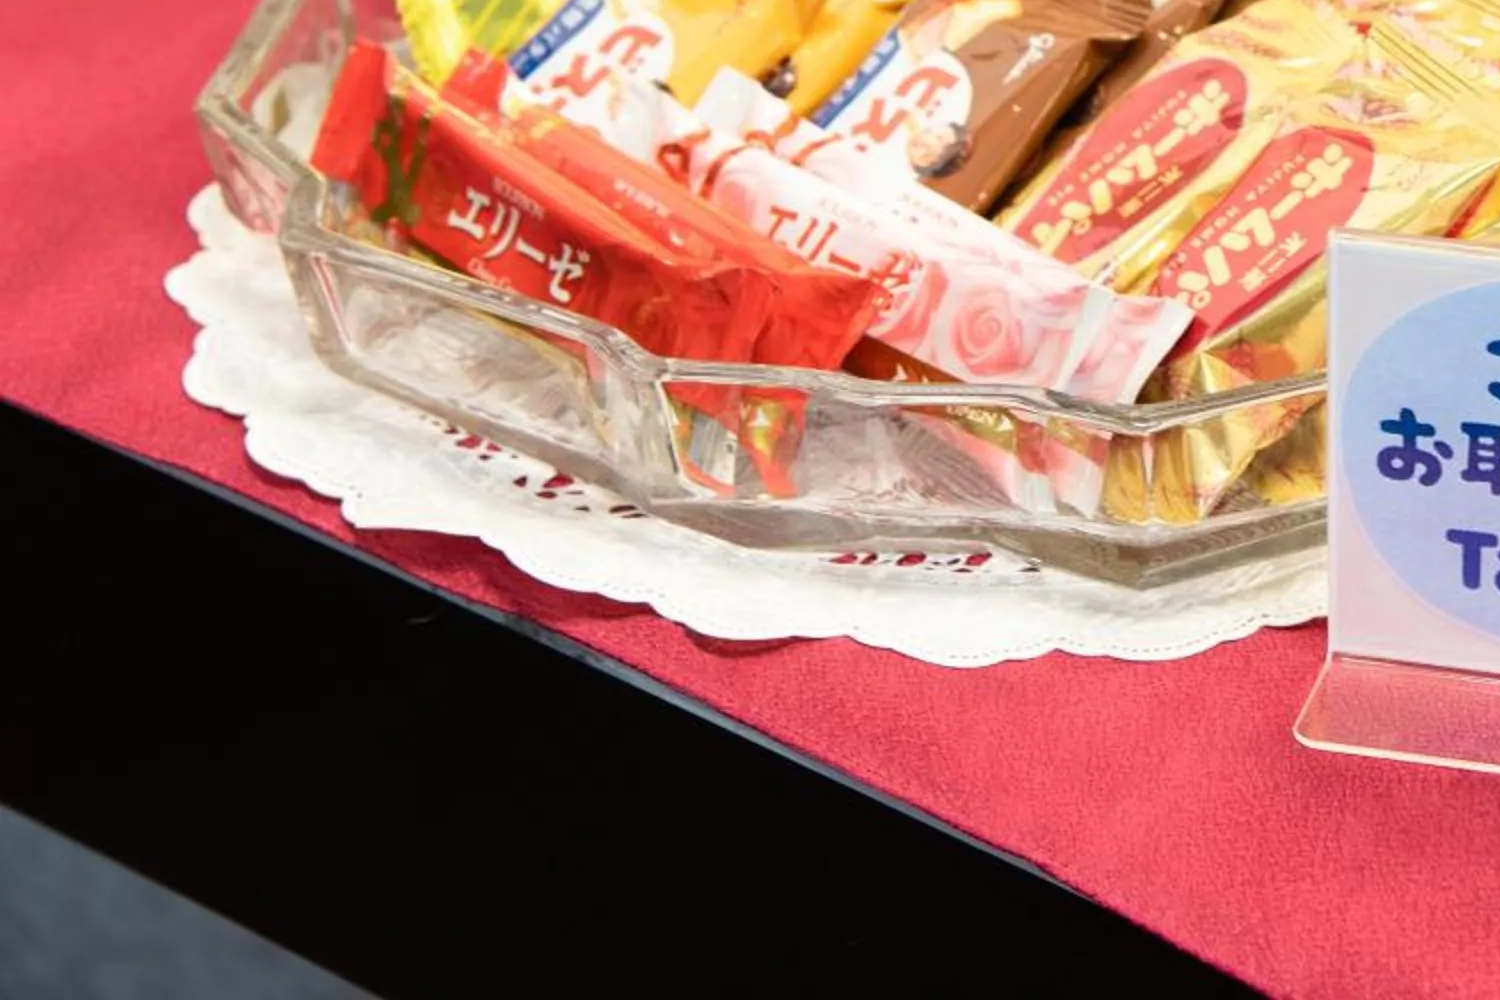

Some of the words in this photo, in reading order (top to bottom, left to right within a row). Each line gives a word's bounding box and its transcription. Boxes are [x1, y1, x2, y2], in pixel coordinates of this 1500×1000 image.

[446, 184, 591, 304] エリーゼ
[1174, 142, 1354, 311] ホームパ
